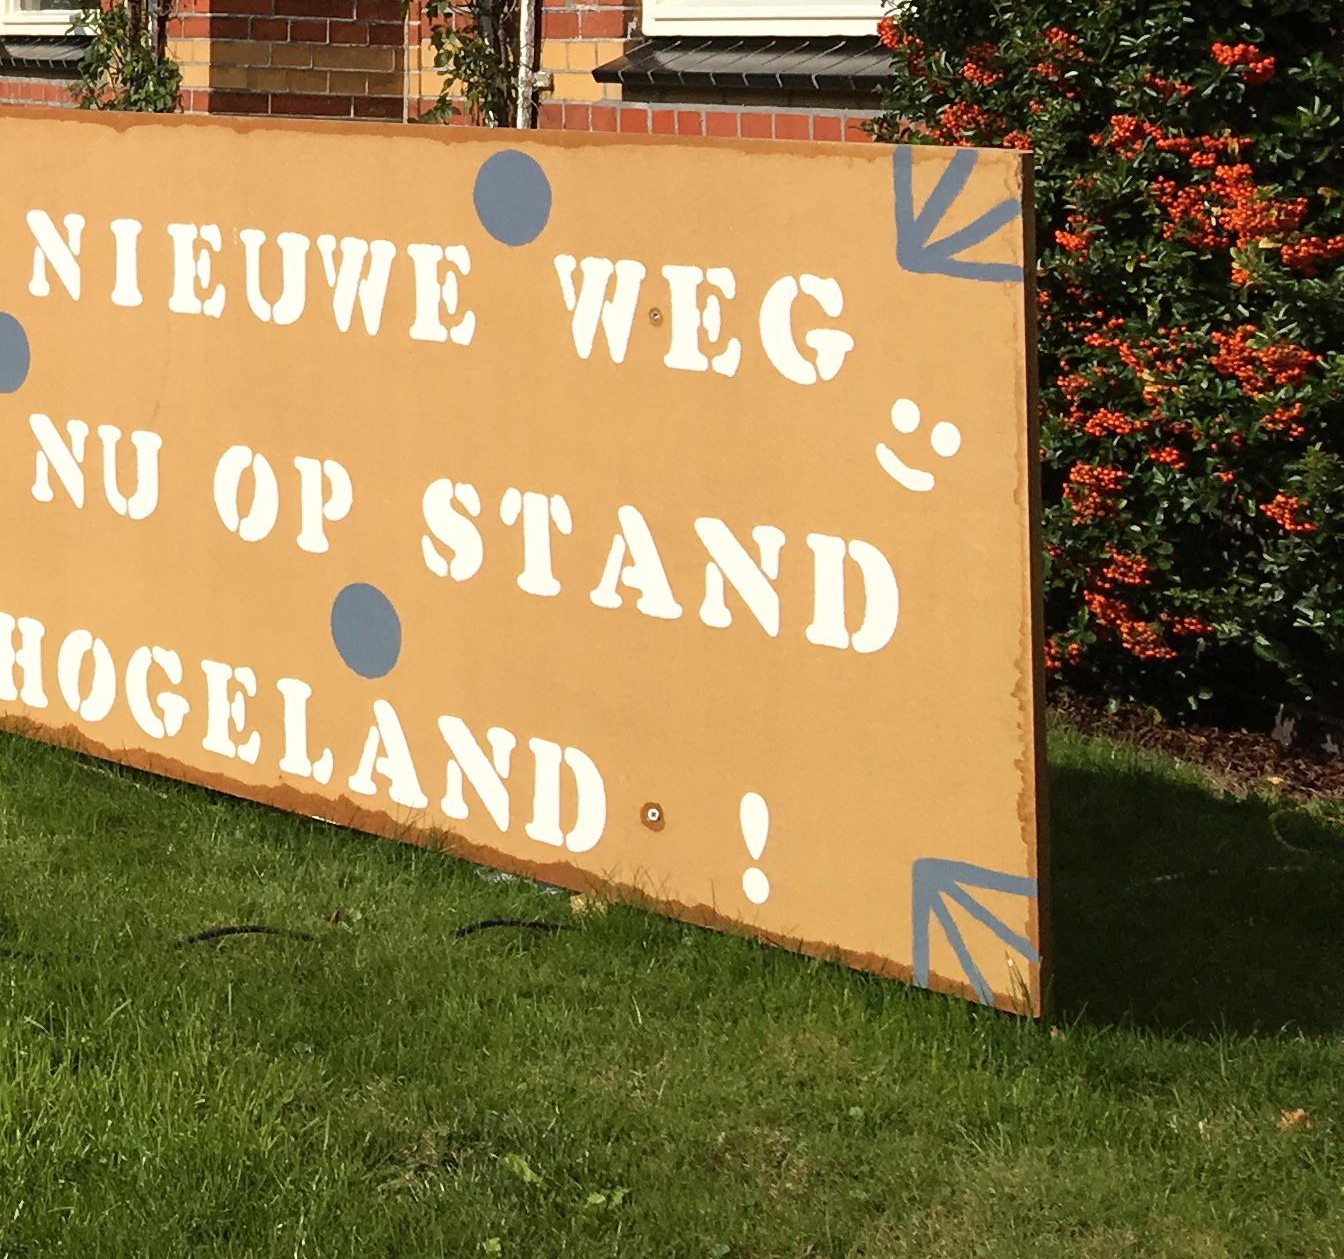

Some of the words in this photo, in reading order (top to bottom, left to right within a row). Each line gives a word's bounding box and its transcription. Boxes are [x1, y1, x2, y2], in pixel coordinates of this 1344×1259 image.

[26, 209, 476, 346] NIEUWE
[553, 253, 855, 386] WEG
[29, 413, 163, 520] NU
[213, 445, 354, 554] OP
[421, 478, 900, 655] STAND
